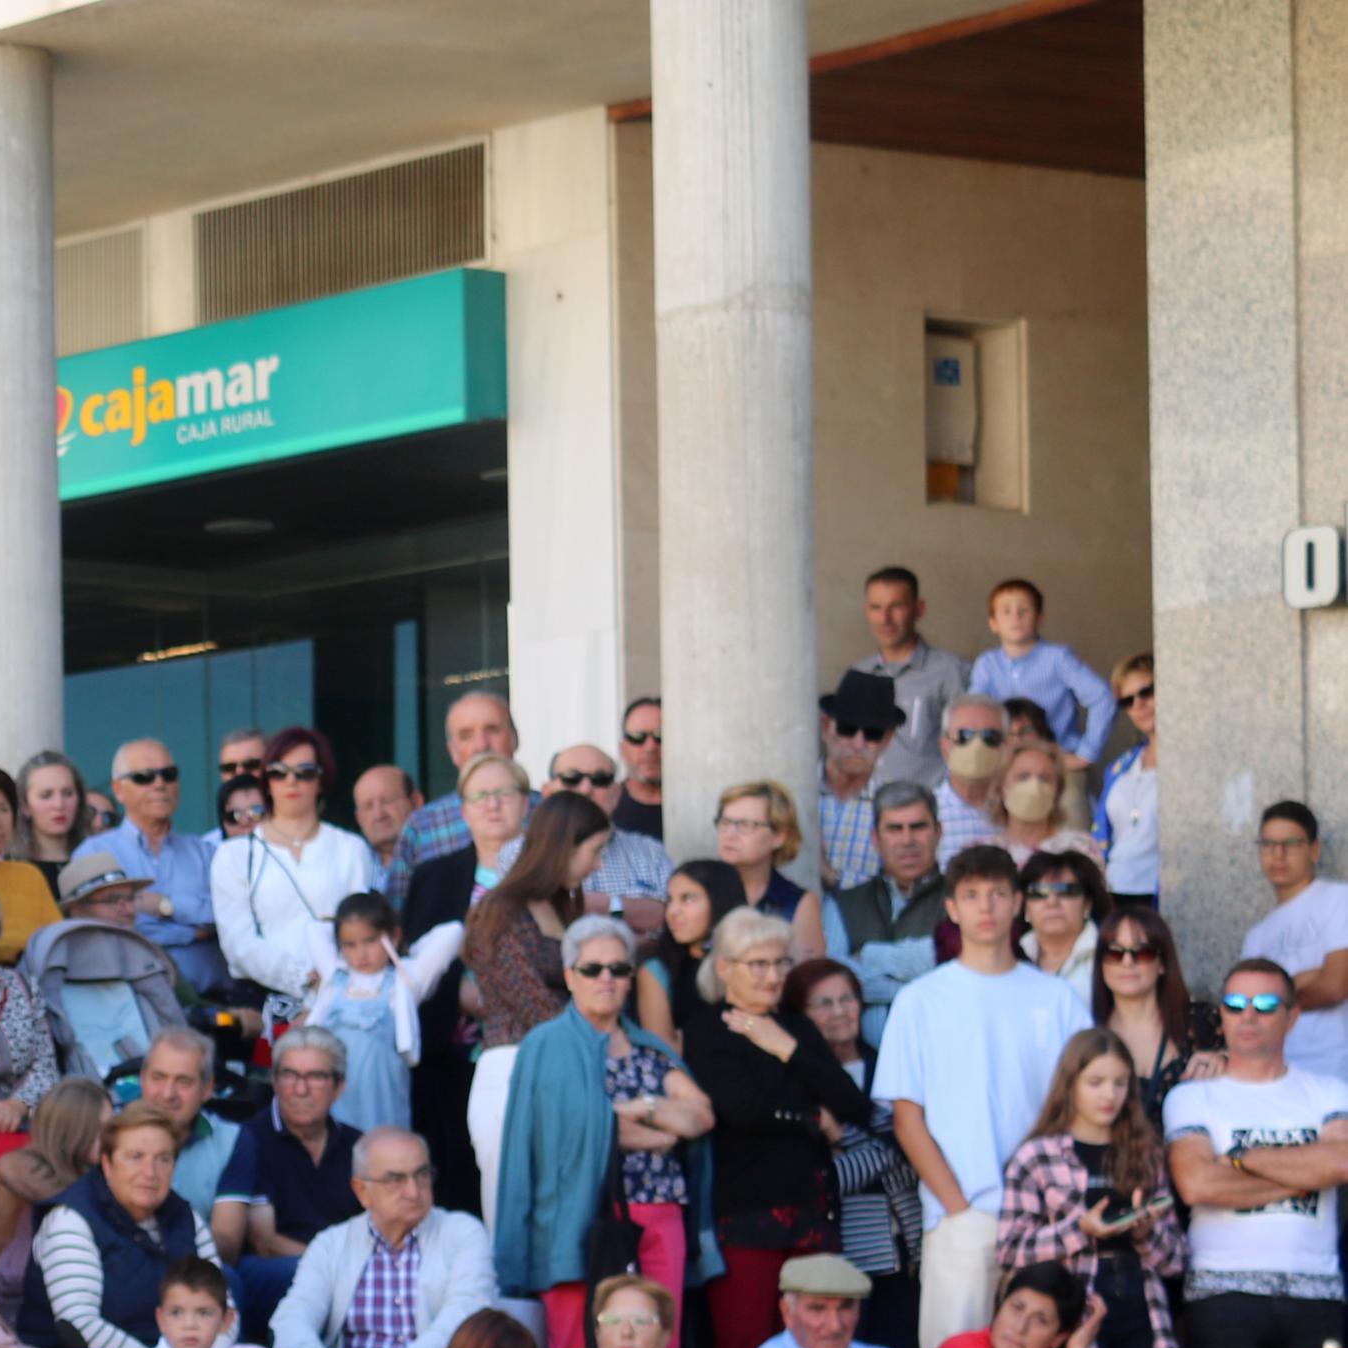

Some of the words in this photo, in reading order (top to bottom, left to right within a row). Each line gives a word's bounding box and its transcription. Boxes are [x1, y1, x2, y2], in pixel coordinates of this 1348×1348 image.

[79, 355, 280, 447] cajamar
[176, 421, 219, 445] CAJA
[220, 407, 275, 435] RURAL
